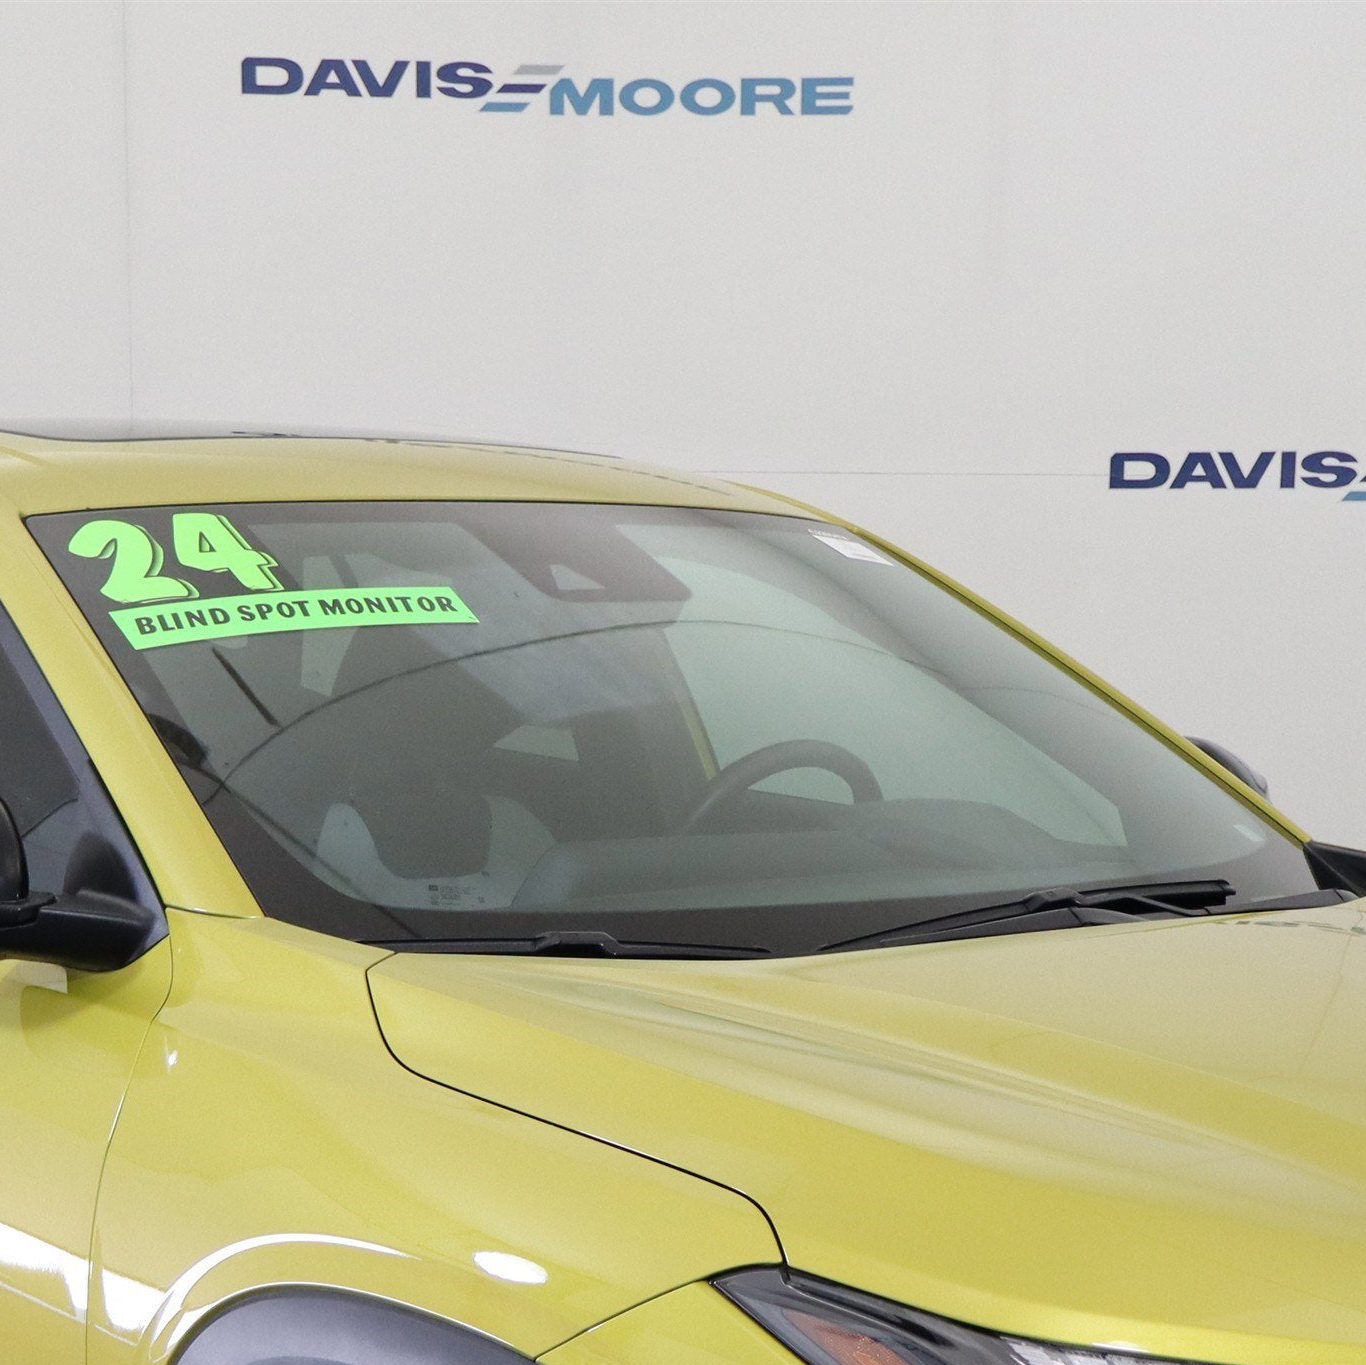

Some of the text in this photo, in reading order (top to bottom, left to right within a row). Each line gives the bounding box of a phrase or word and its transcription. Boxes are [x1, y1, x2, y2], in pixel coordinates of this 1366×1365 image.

[241, 57, 855, 117] DAVIS MOORE
[1109, 451, 1358, 489] DAVIS
[68, 513, 284, 604] 24
[134, 596, 458, 635] BLIND SPOT MONITOR
